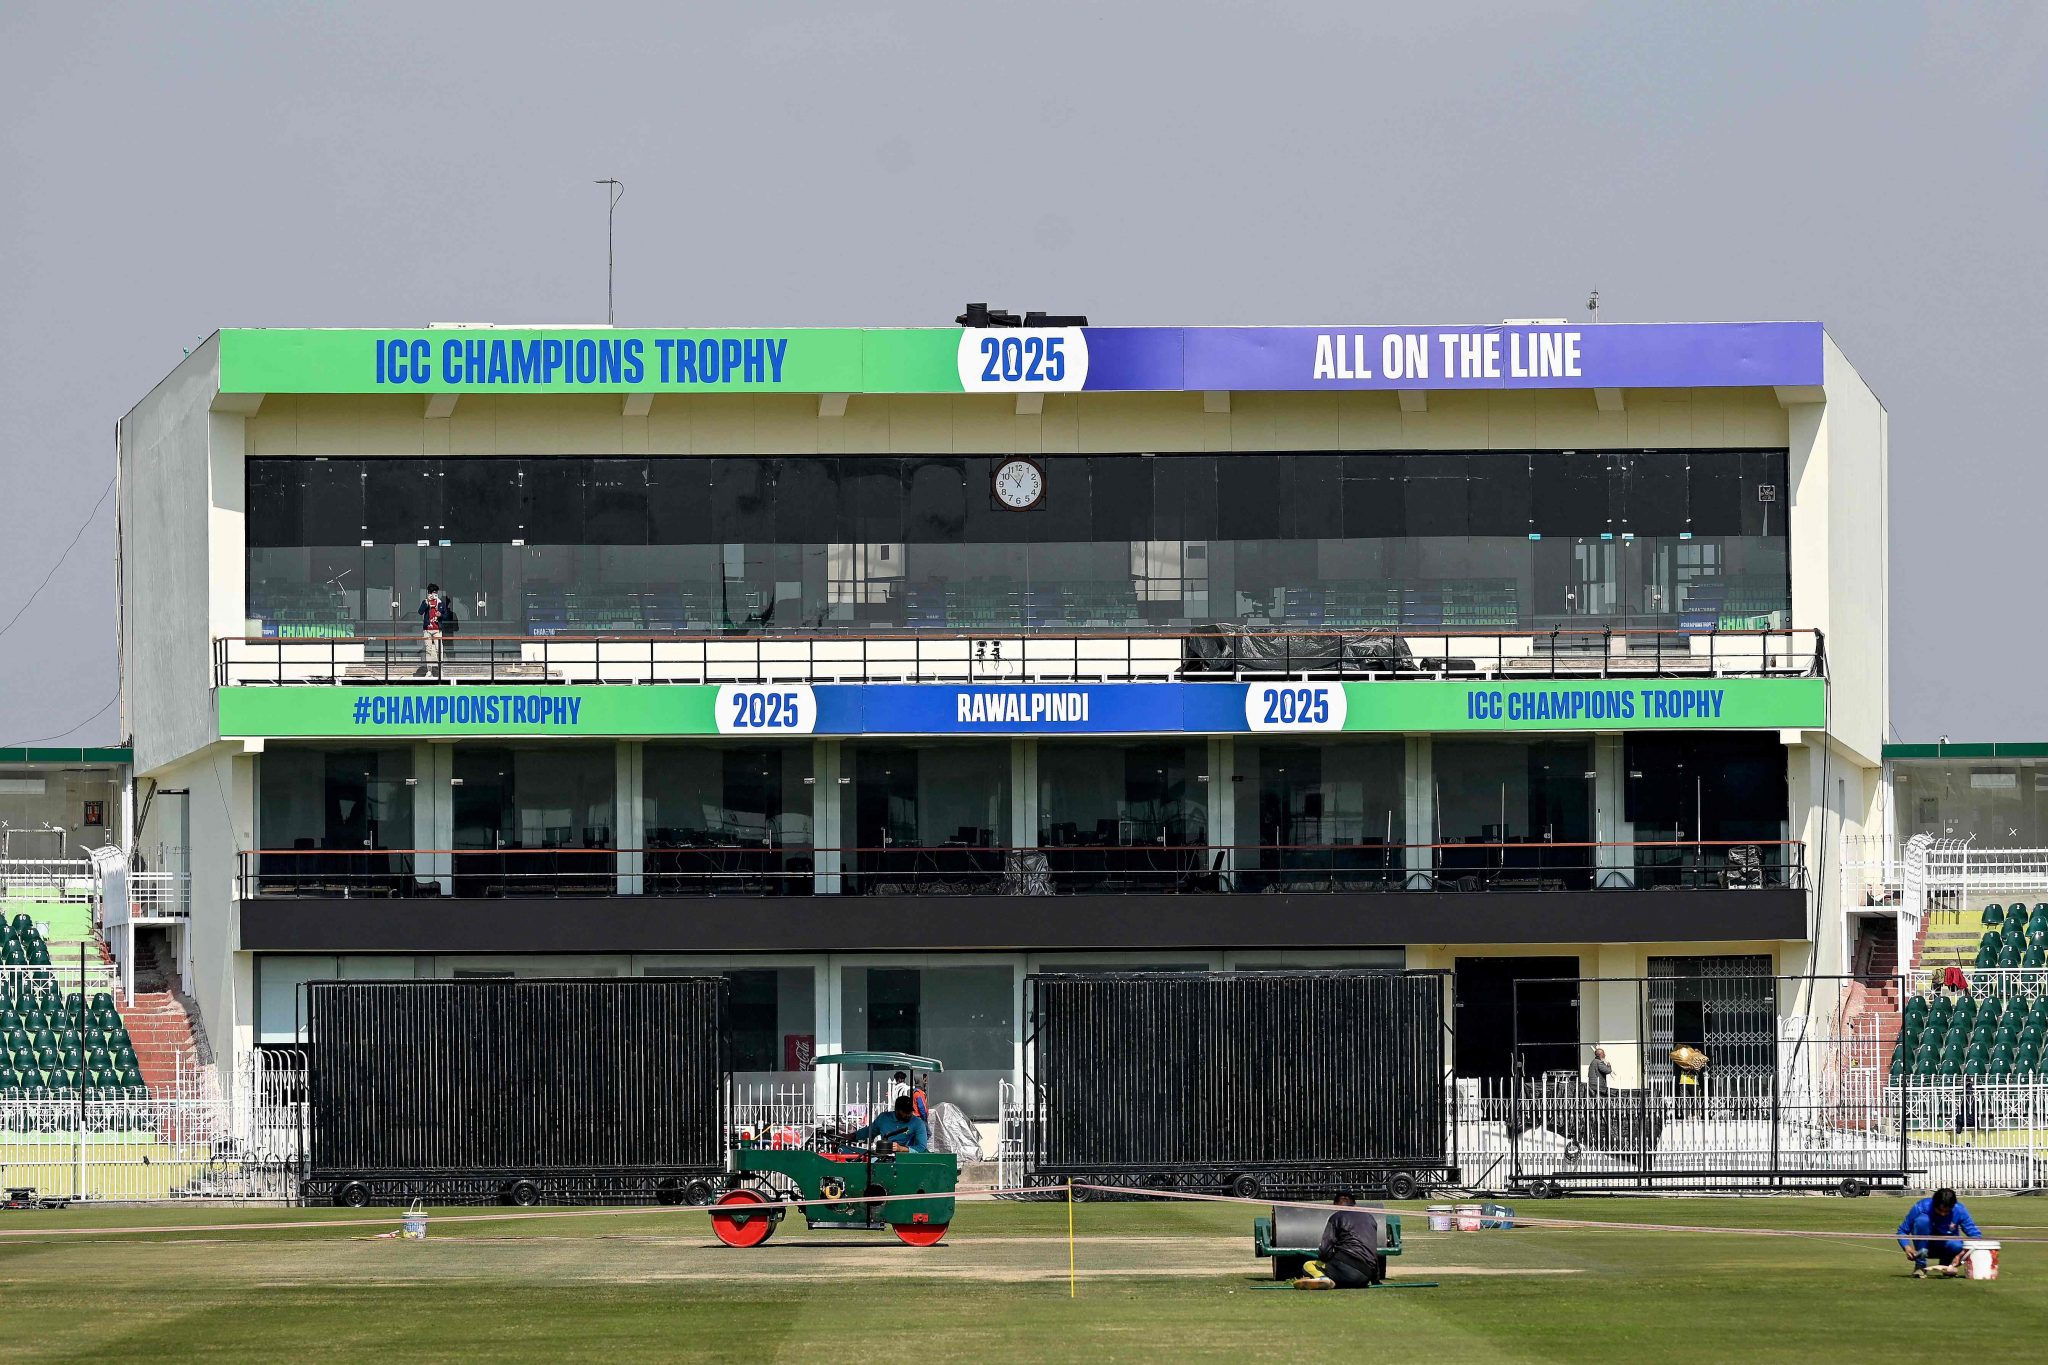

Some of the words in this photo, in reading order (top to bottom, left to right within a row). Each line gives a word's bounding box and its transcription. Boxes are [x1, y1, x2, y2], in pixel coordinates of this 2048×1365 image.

[376, 339, 431, 384] ICC
[442, 339, 644, 385] CHAMPIONS
[655, 338, 788, 384] TROPHY
[980, 337, 1065, 382] 2025
[1313, 334, 1372, 380] ALL
[1383, 333, 1429, 380] ON
[1438, 333, 1501, 379] THE
[1510, 332, 1582, 378] LINE
[1015, 464, 1023, 472] 12
[278, 623, 354, 638] CHAMPIONS
[353, 694, 581, 726] #CHAMPIONSTROPHY
[733, 692, 798, 728] 2025
[957, 692, 1089, 722] RAWALPINDI
[1263, 688, 1329, 724] 2025
[1467, 691, 1503, 720] ICC
[1507, 690, 1635, 721] CHAMPIONS
[1641, 689, 1724, 718] TROPHY
